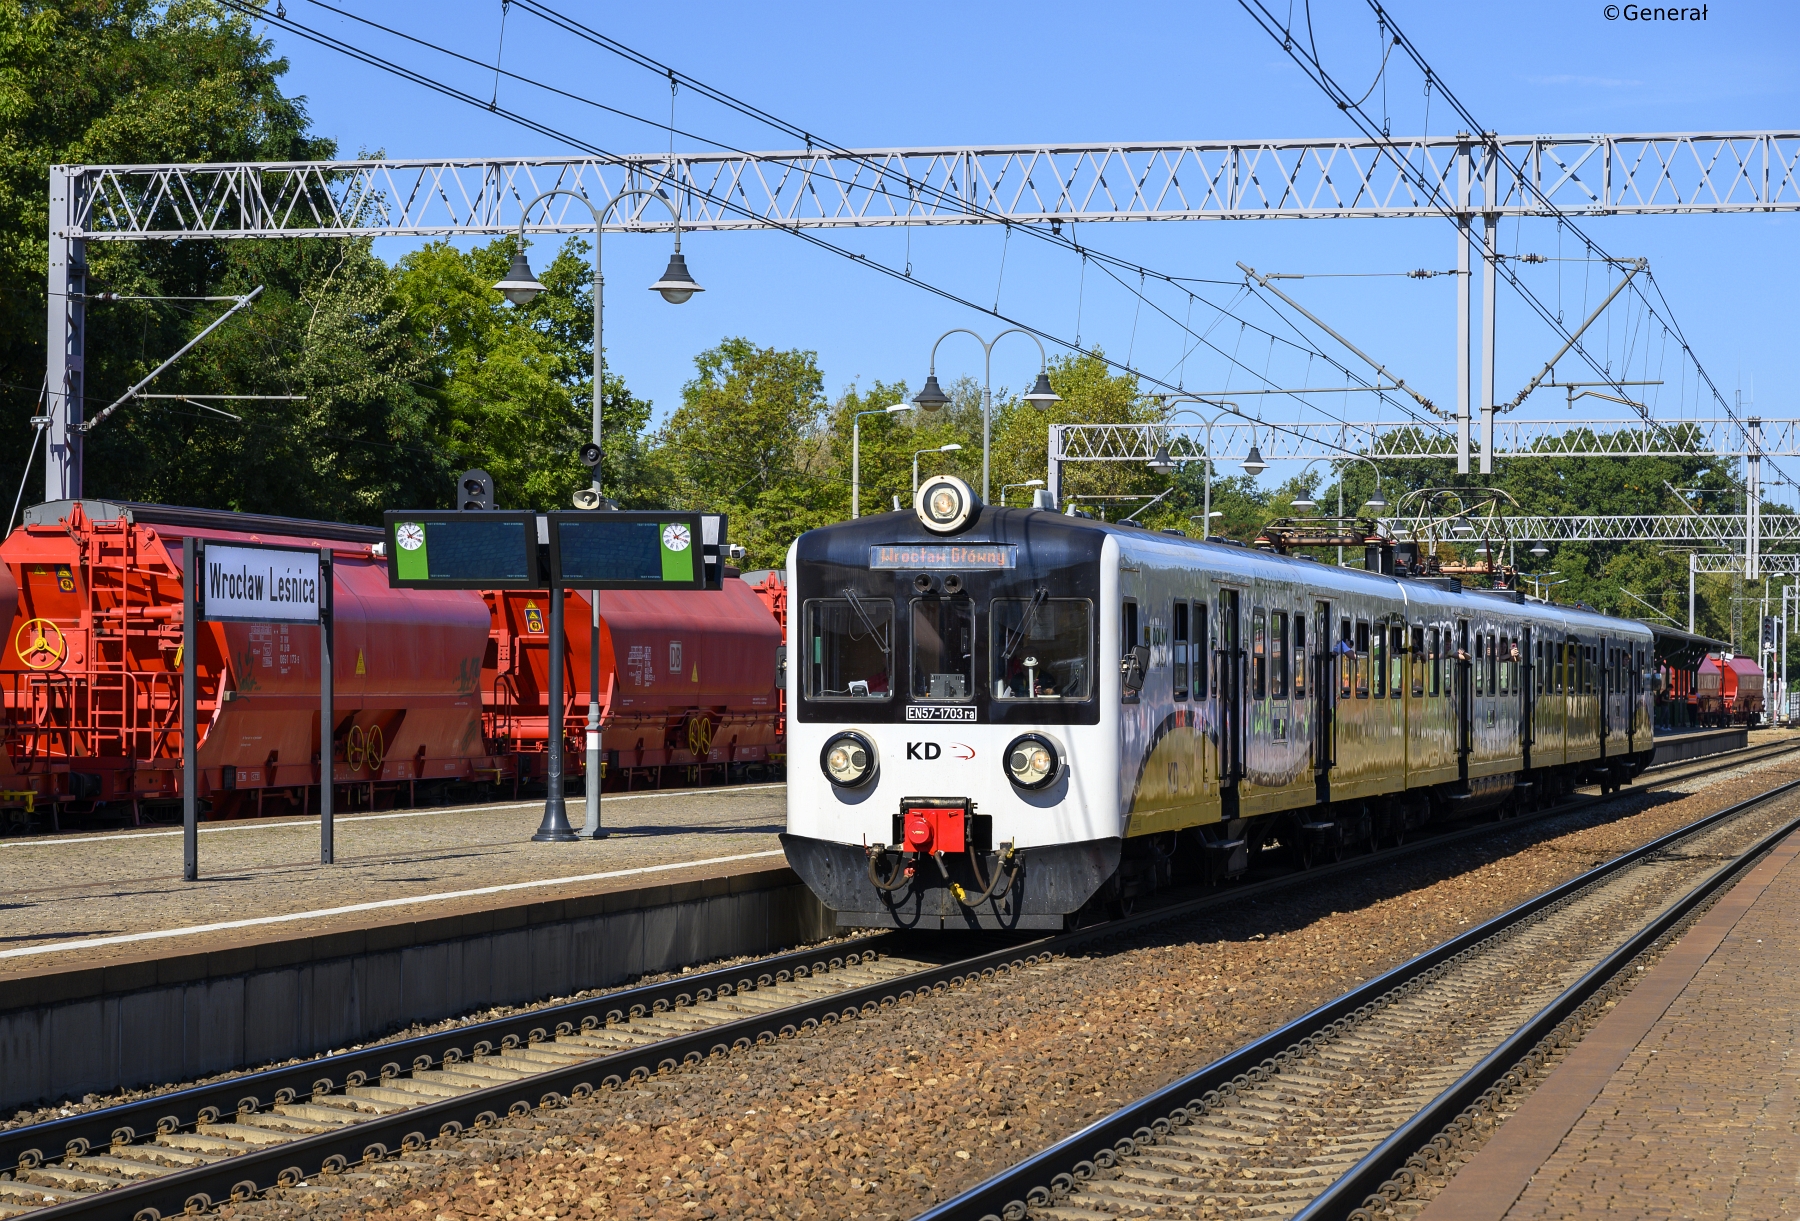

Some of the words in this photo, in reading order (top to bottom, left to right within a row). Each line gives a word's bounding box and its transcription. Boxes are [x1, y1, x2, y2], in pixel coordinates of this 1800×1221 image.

[881, 547, 945, 563] Wrocław
[951, 547, 1005, 566] Główny
[210, 562, 264, 601] Wrocław
[269, 566, 315, 604] Leśnica
[670, 645, 681, 670] DB
[908, 707, 963, 719] EN57-1703
[964, 710, 975, 719] ra
[906, 742, 942, 760] KD
